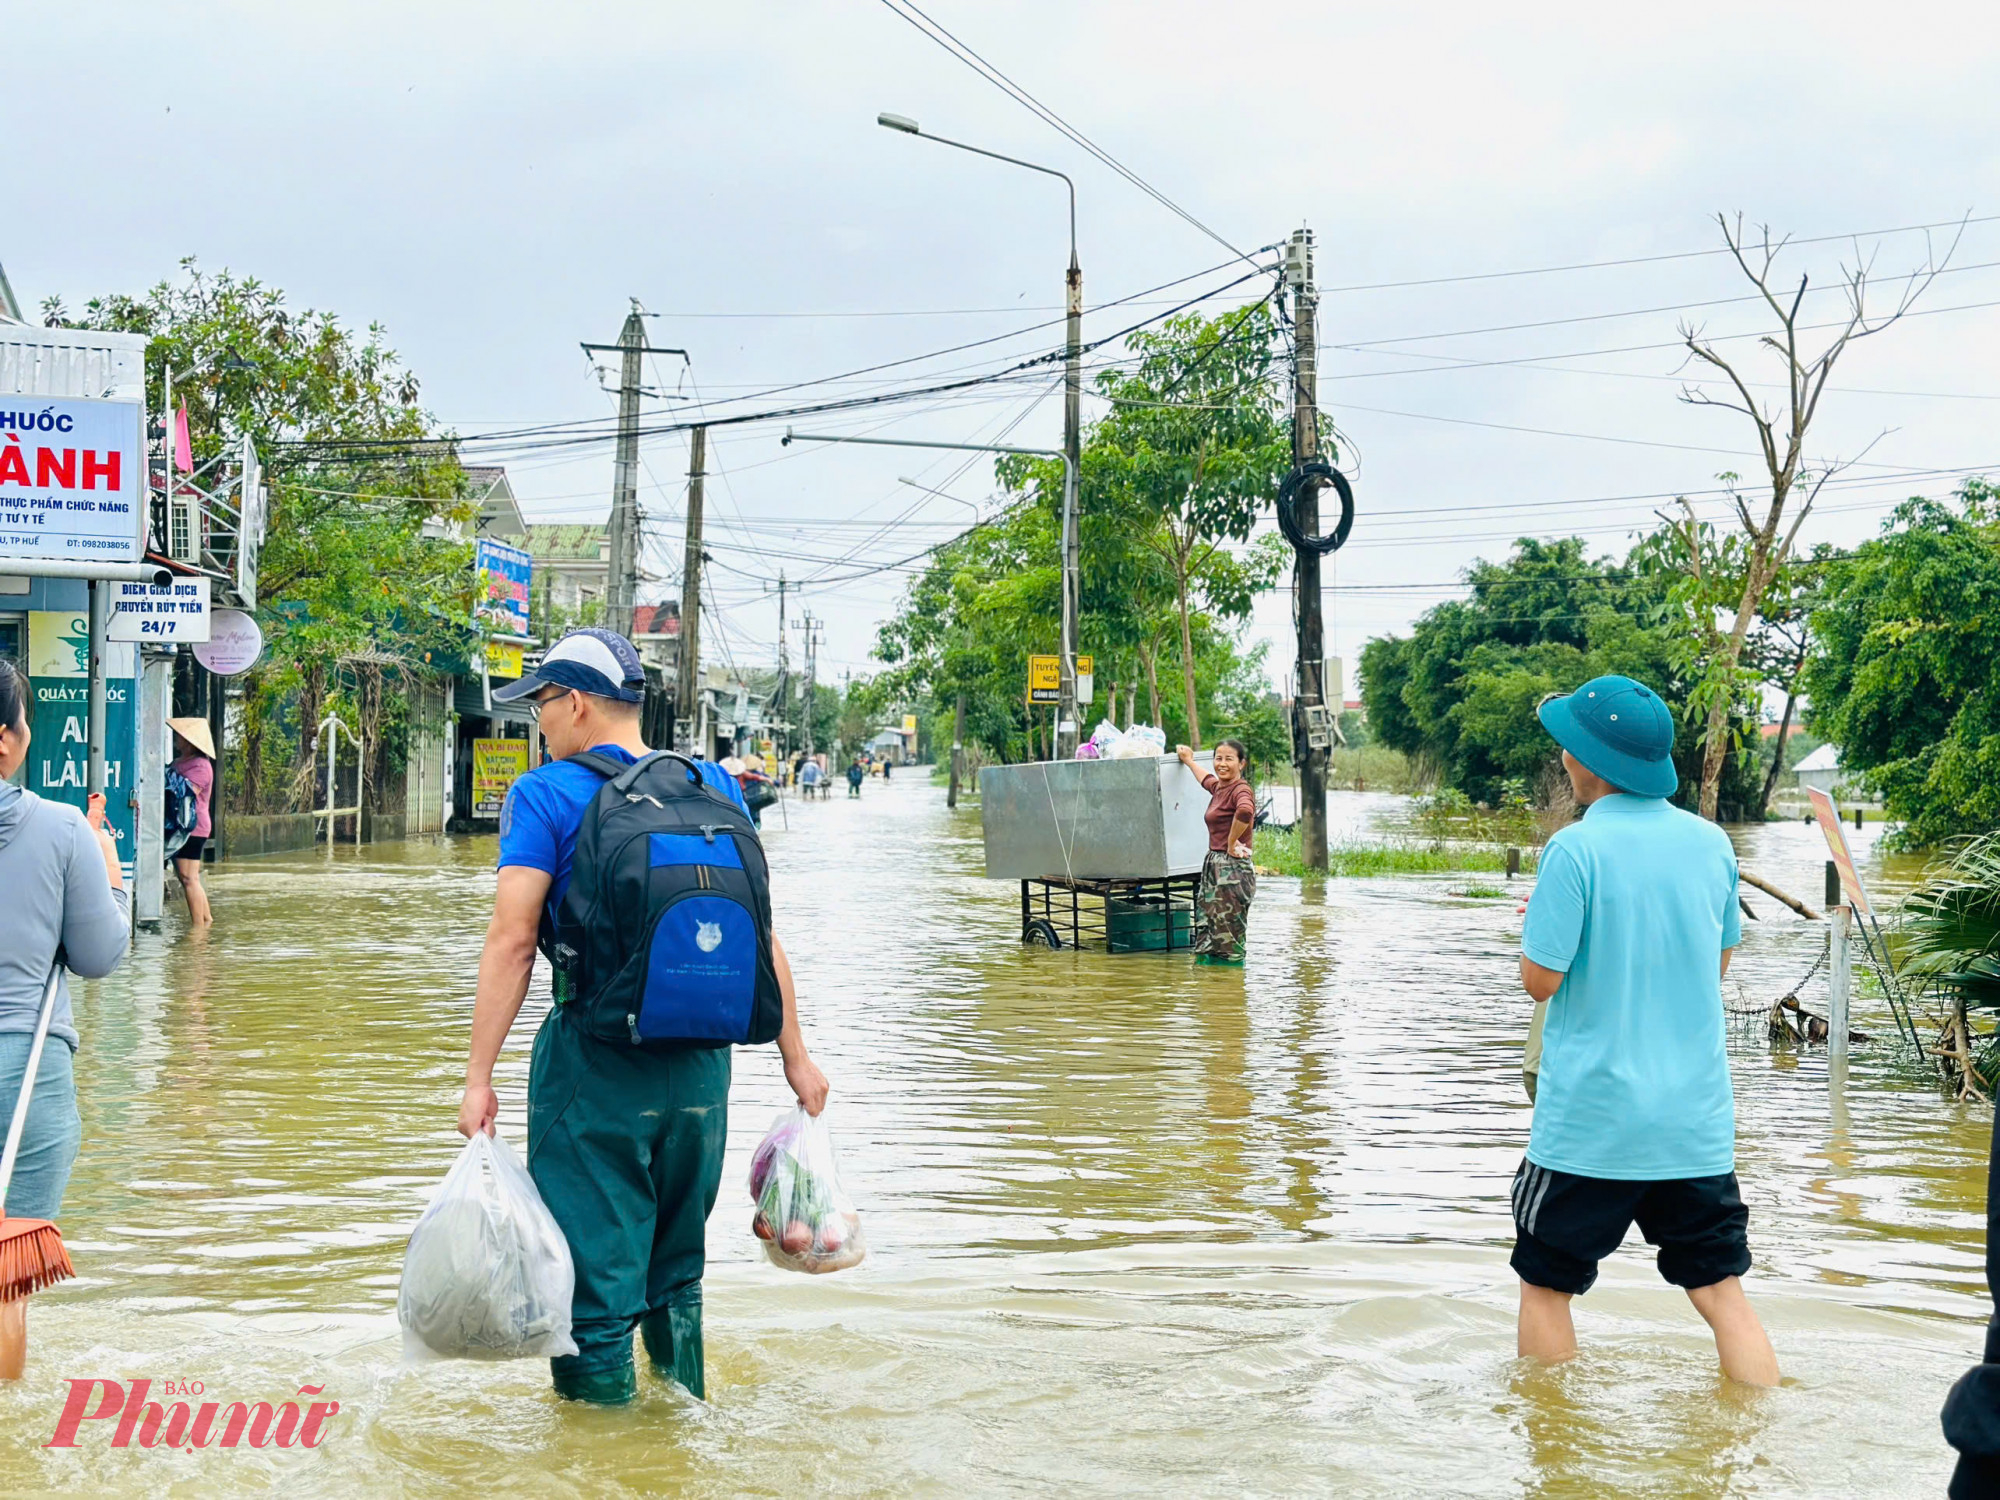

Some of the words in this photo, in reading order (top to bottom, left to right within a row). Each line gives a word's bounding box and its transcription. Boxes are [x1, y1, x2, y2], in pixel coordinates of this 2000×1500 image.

[0, 497, 27, 510] THỰC
[30, 496, 62, 510] PHẨM
[66, 499, 96, 511] CHỨC
[99, 501, 129, 513] NĂNG
[6, 513, 20, 523] TƯ
[22, 514, 29, 525] Y
[32, 512, 45, 525] TẾ
[10, 536, 20, 546] TP
[22, 535, 40, 546] HUẾ
[82, 540, 130, 550] 0982038056
[175, 585, 197, 598] DỊCH
[156, 599, 177, 613] RÚT
[141, 620, 176, 636] 24/7
[43, 750, 121, 788] LÀH
